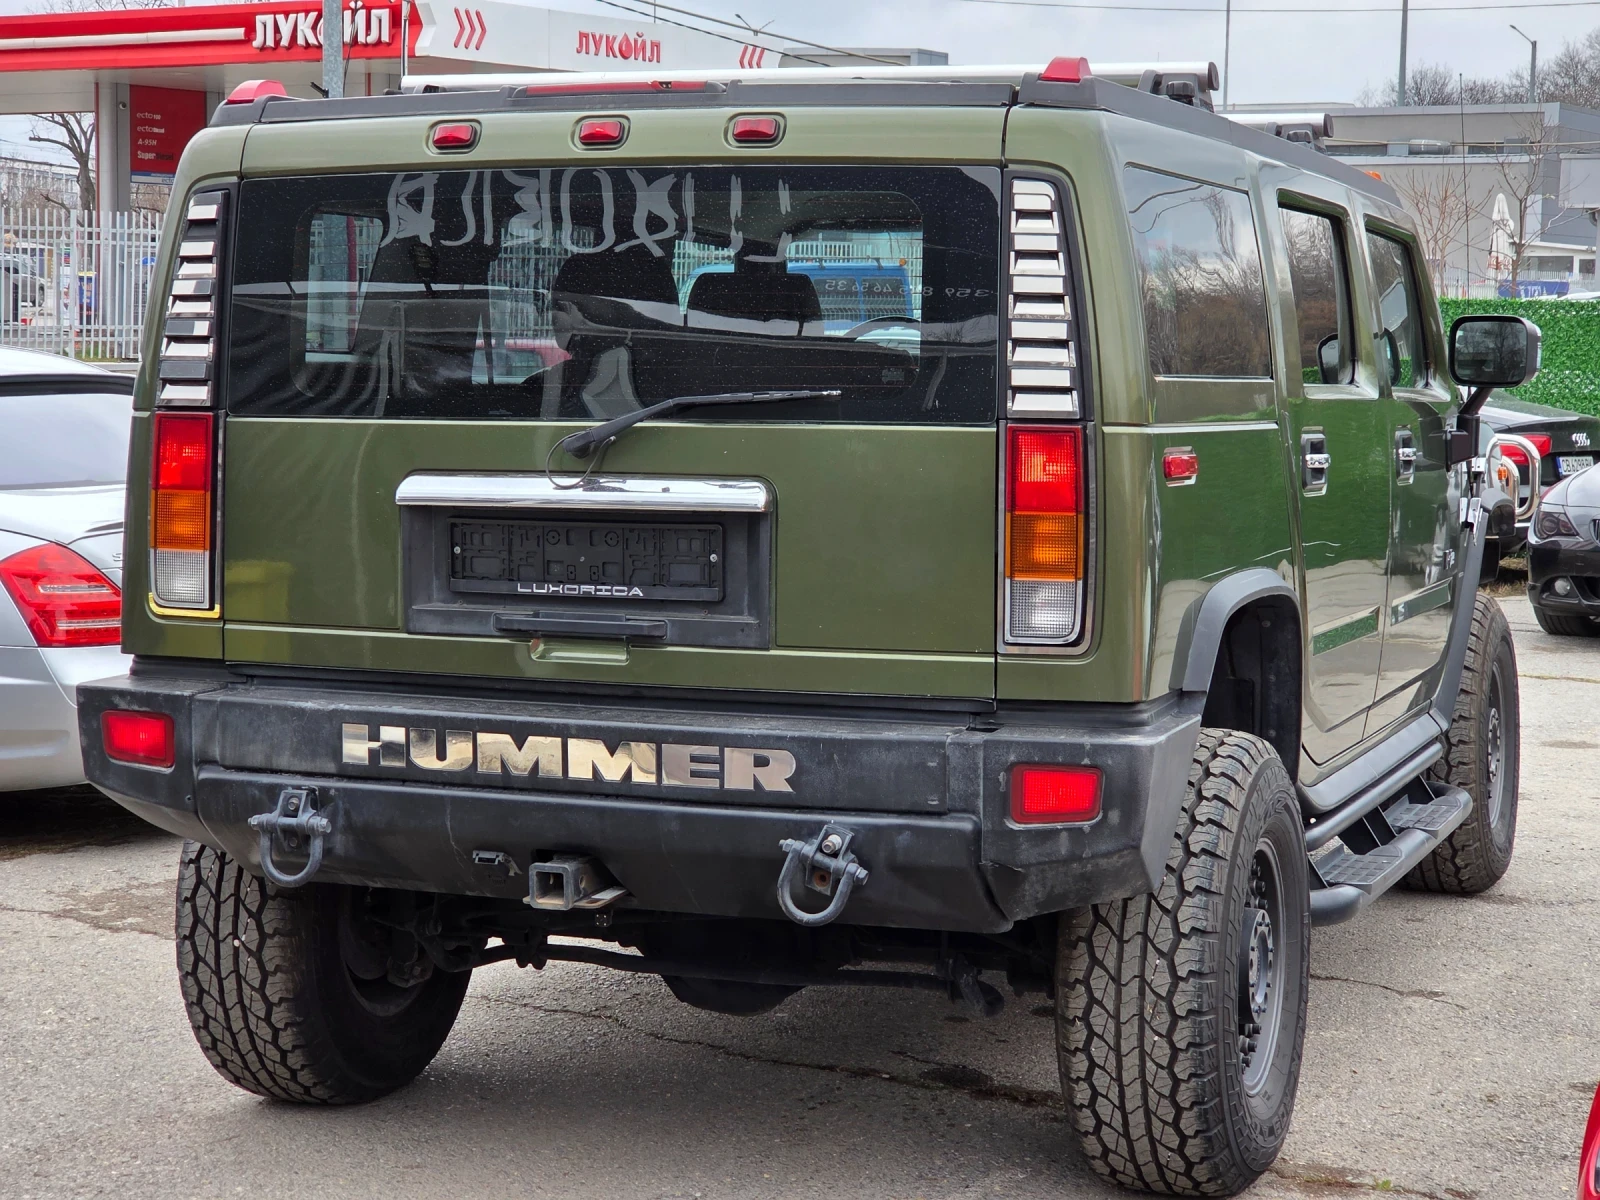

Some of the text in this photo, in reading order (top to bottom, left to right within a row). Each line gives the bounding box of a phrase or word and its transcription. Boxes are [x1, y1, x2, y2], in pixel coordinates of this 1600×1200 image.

[252, 1, 390, 48] ЛУКЙЛ
[576, 30, 660, 63] ЛУКОЙЛ
[517, 583, 644, 597] LUXORICA
[341, 723, 797, 793] HUMMER
